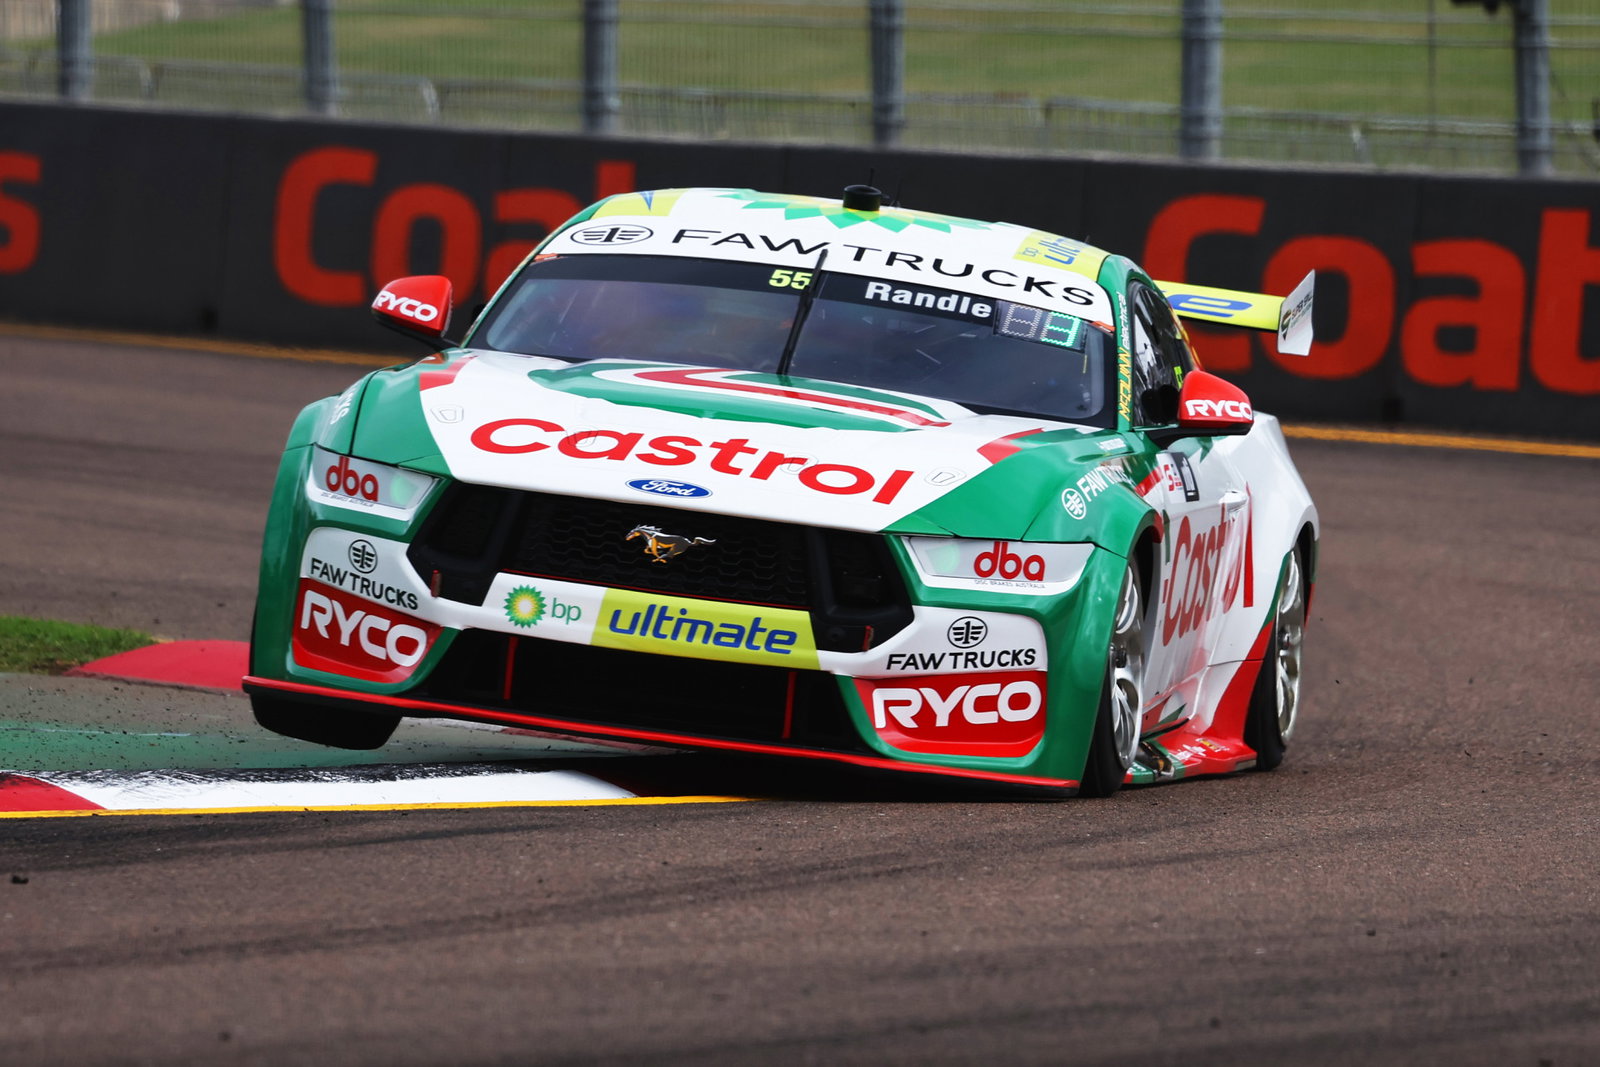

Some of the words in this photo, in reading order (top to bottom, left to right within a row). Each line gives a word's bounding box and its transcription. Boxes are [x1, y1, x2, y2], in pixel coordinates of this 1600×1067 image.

[671, 229, 831, 255] FAW
[843, 244, 1094, 306] TRUCKS
[768, 269, 813, 290] 55
[376, 290, 438, 322] RYCO
[865, 281, 992, 318] Randle
[1185, 399, 1253, 421] RYCO
[325, 455, 379, 502] dba
[470, 418, 914, 505] Castrol
[641, 480, 697, 496] Ford
[974, 541, 1046, 582] dba
[310, 557, 348, 587] FAW
[349, 572, 419, 610] TRUCKS
[300, 589, 428, 668] RYCO
[551, 597, 582, 624] bp
[609, 603, 798, 655] ultimate
[886, 652, 946, 671] FAW
[948, 648, 1037, 670] TRUCKS
[872, 680, 1043, 729] RYCO
